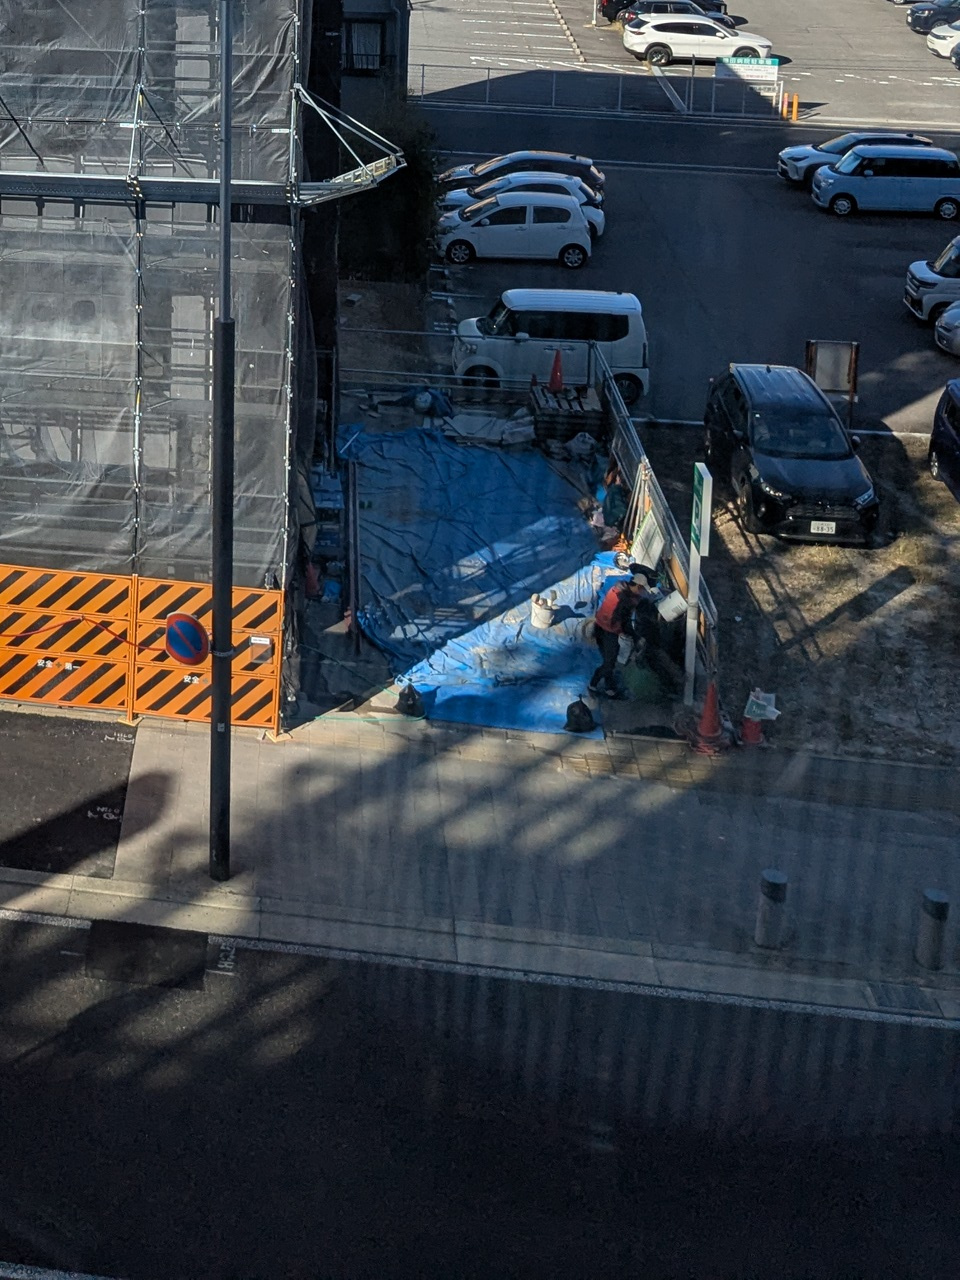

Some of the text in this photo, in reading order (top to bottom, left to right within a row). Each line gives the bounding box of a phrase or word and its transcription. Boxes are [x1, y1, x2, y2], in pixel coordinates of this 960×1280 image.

[36, 659, 81, 671] 安全 第一
[183, 675, 200, 684] 安全
